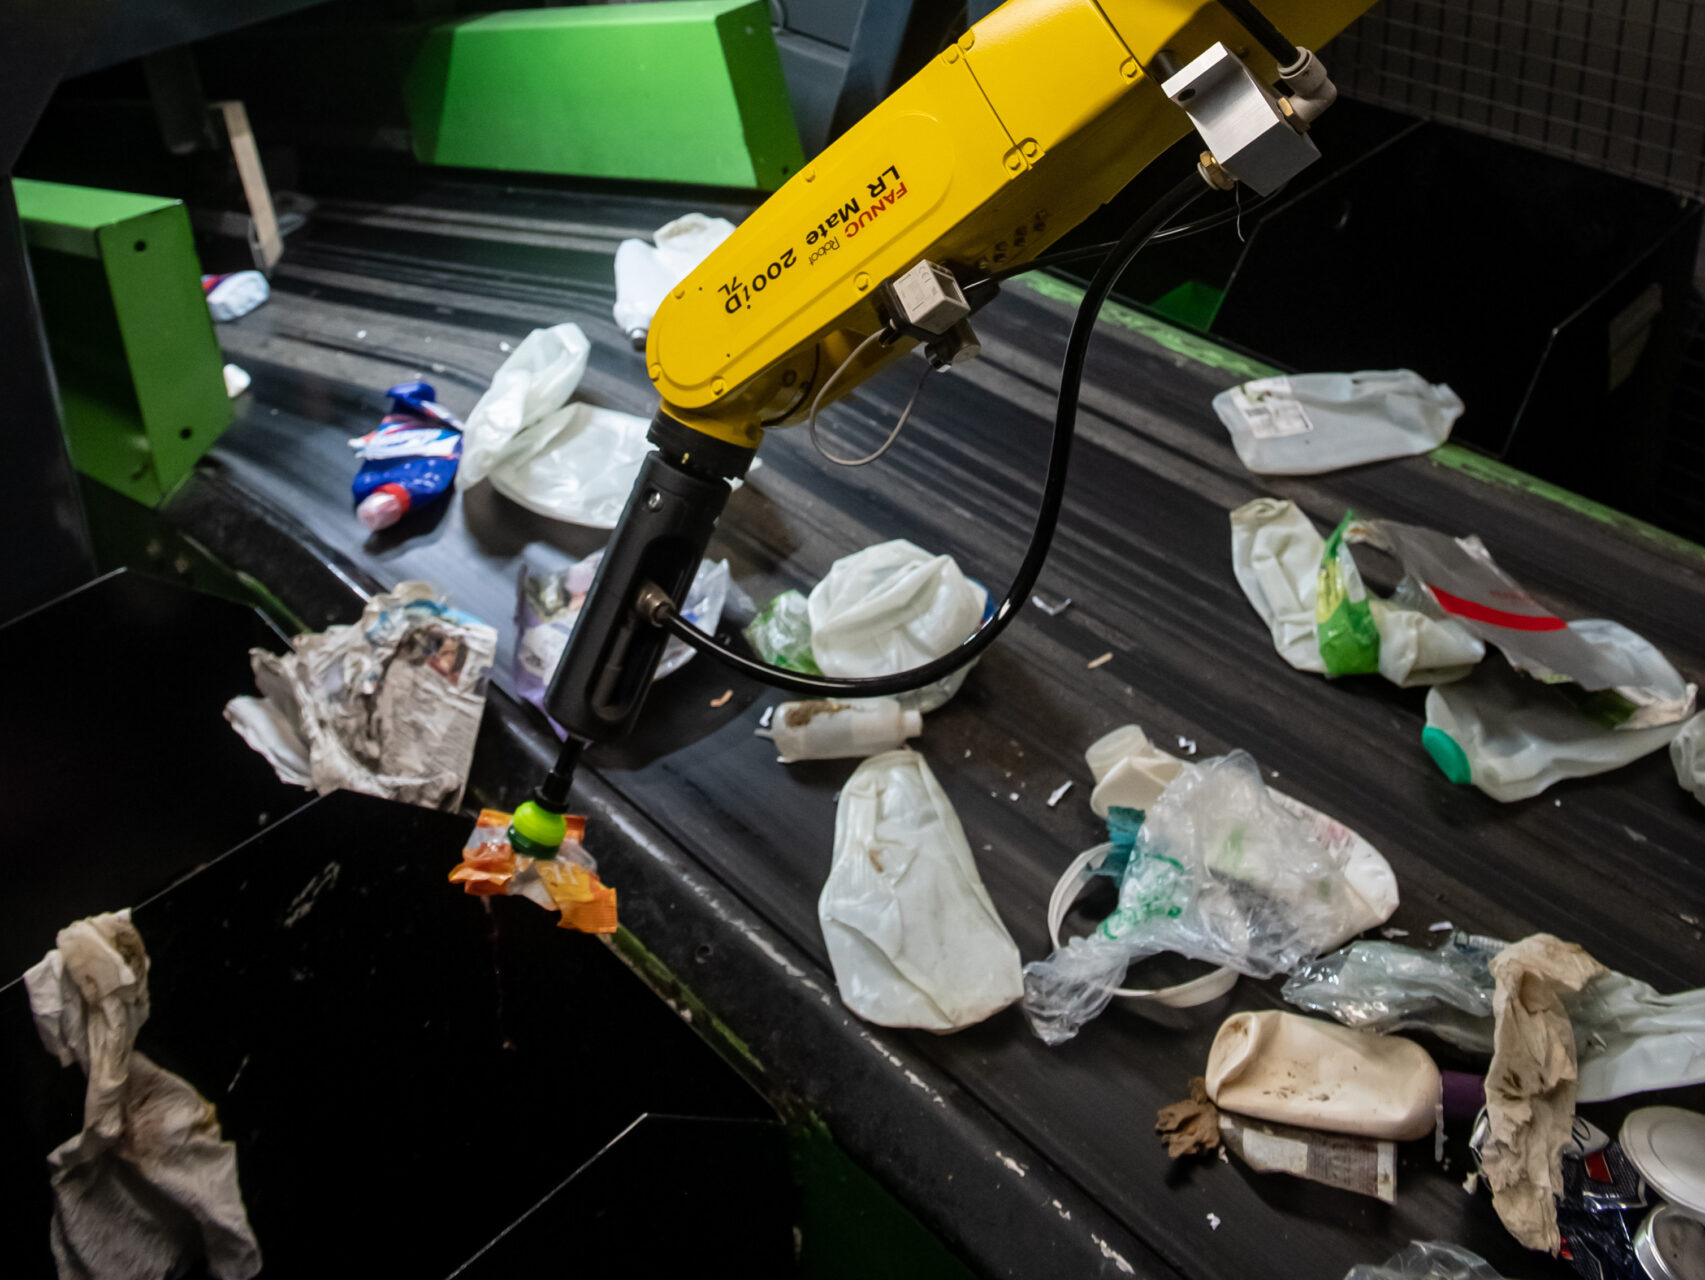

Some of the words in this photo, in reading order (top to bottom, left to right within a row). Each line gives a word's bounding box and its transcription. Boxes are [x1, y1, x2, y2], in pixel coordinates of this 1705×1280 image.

[866, 165, 900, 198] LR
[805, 197, 860, 245] Mate
[844, 181, 908, 238] FANUC
[808, 236, 840, 265] Robot
[718, 276, 743, 296] 7L
